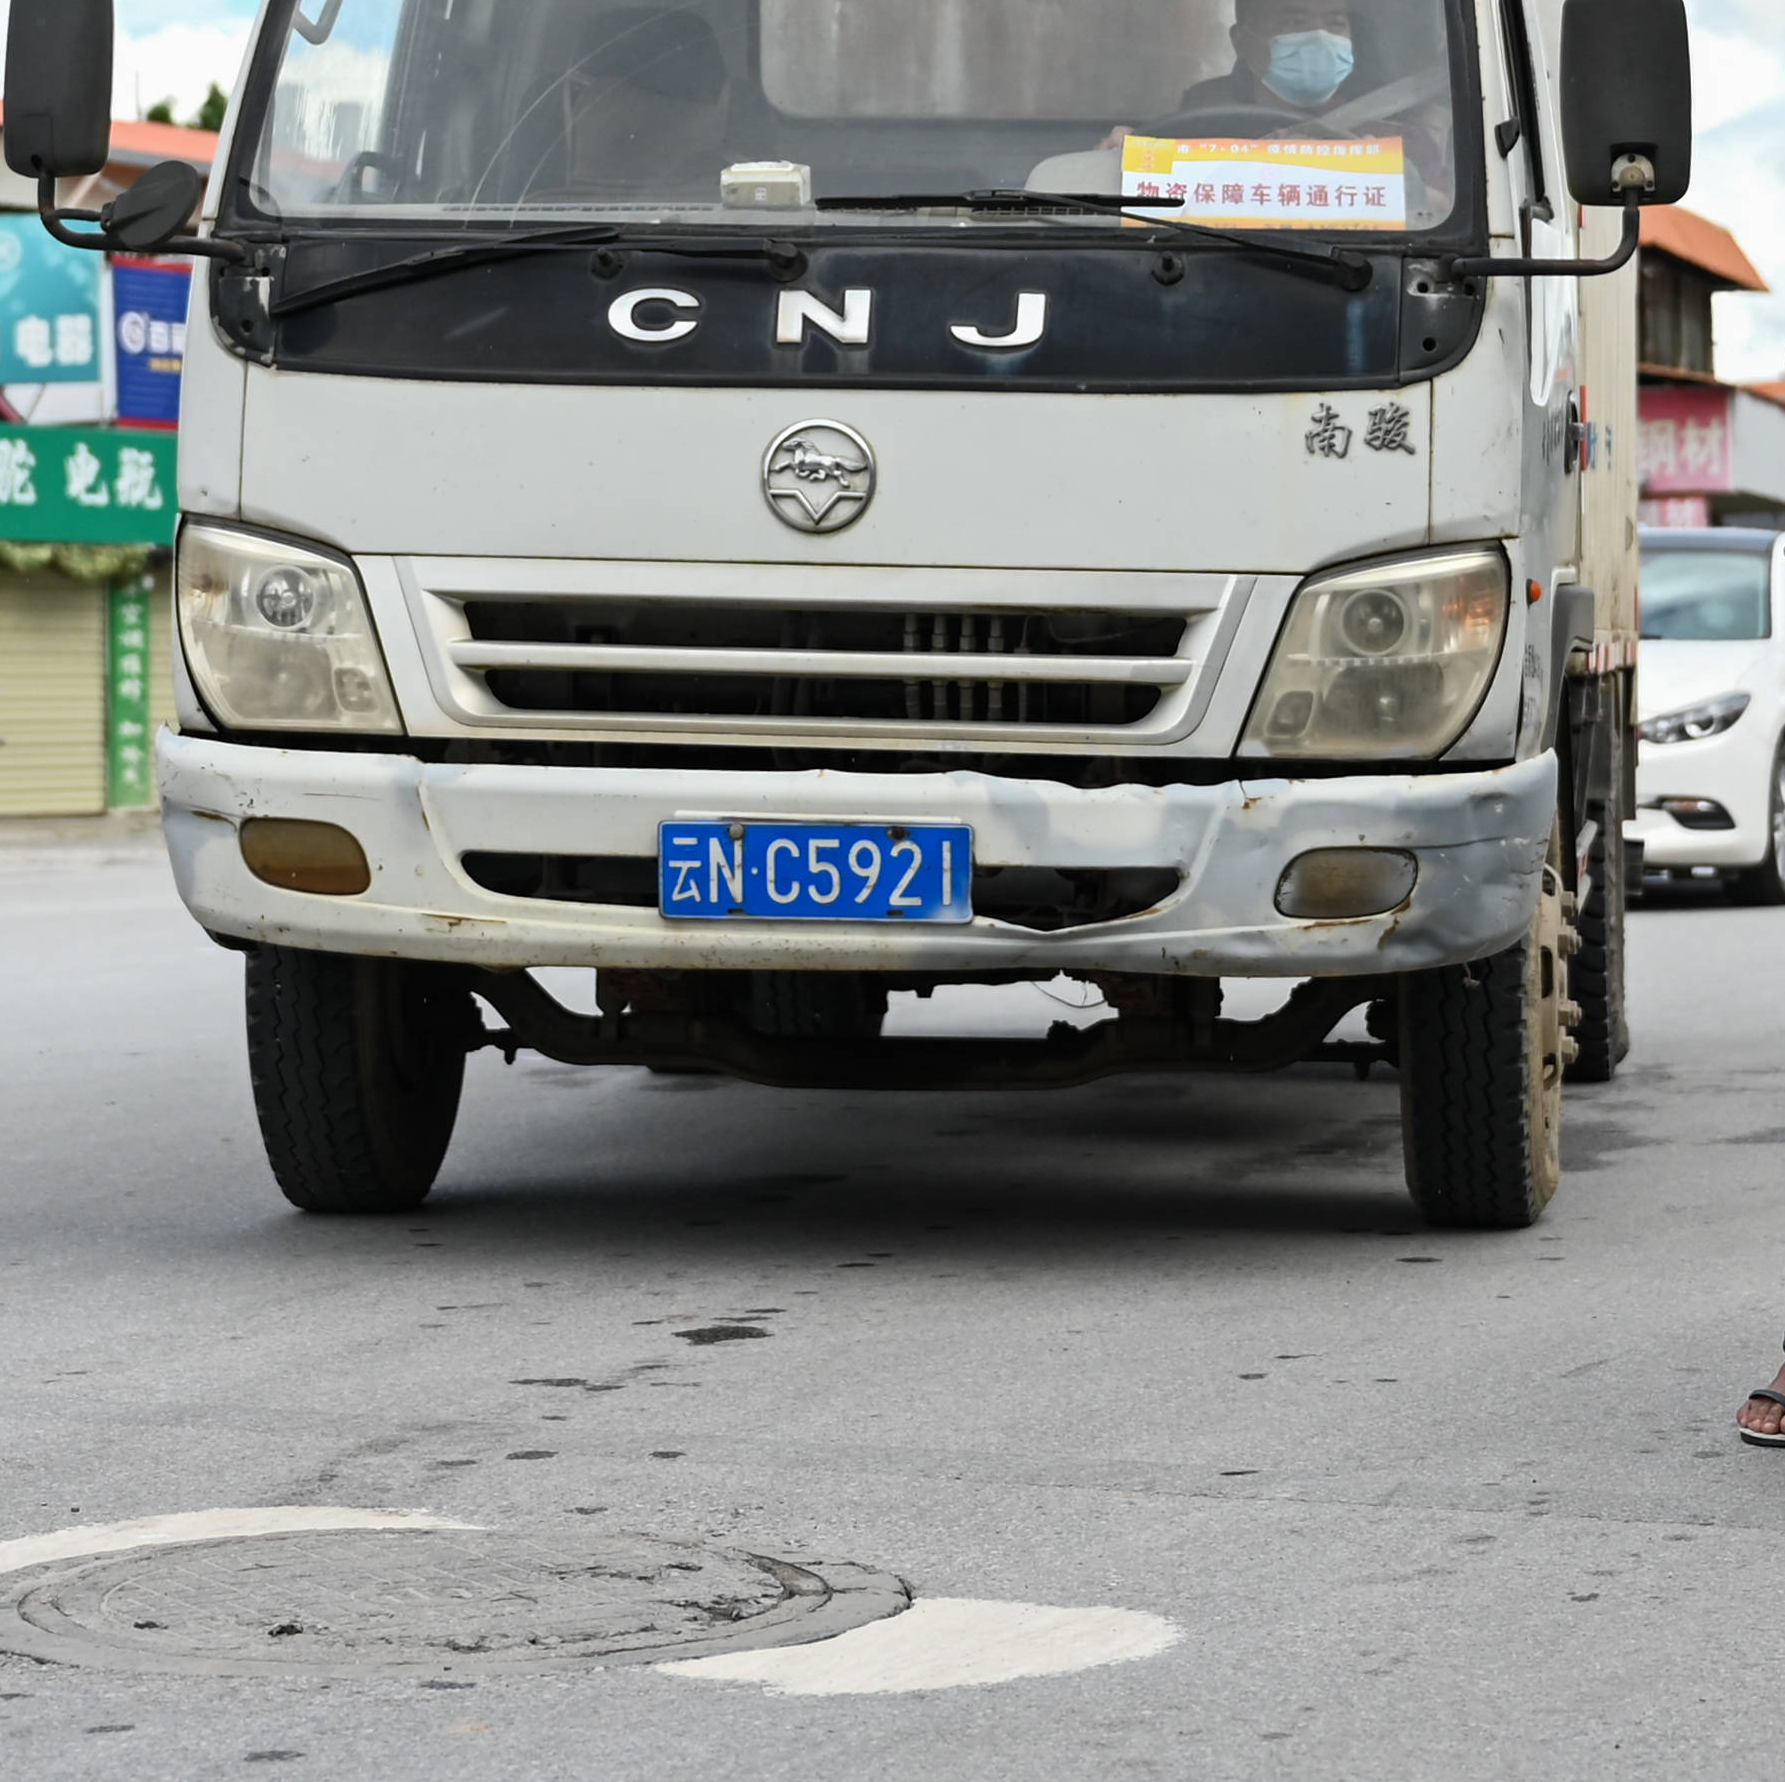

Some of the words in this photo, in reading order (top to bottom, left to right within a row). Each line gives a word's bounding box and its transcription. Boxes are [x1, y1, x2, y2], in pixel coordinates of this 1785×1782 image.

[1136, 181, 1388, 208] 物资保障车辆通行证
[608, 287, 1046, 347] CNJ
[1304, 402, 1416, 459] 南骏
